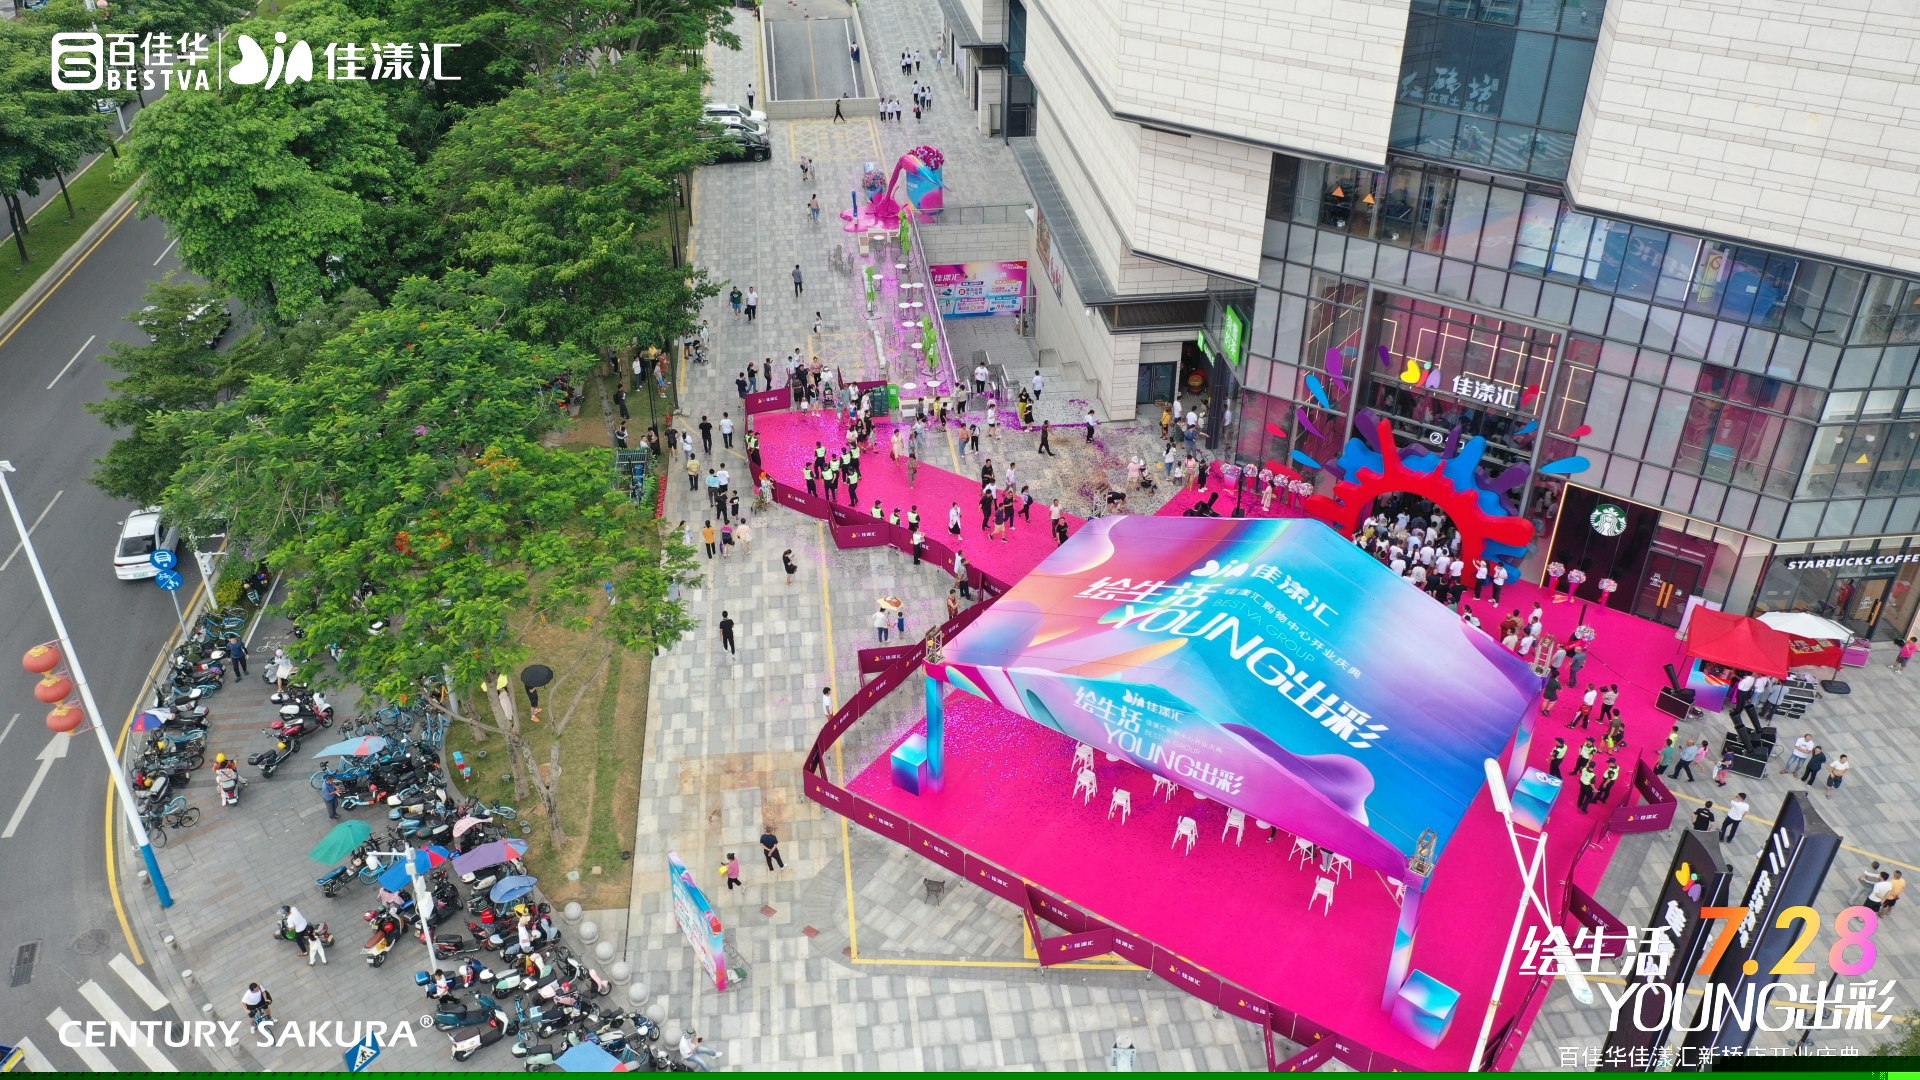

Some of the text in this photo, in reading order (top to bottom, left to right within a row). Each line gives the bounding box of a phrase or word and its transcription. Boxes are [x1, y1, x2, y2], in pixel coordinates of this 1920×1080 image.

[1452, 375, 1519, 408] 佳漾汇
[1073, 576, 1224, 608] 绘生活
[1250, 563, 1339, 627] 佳漾汇
[1788, 556, 1873, 570] STARBUCKS
[1213, 598, 1316, 663] BESTVA GROUP
[1224, 587, 1362, 680] 佳漾汇购物中心开业庆典
[1112, 605, 1389, 748] YOUNG出彩
[1073, 686, 1143, 734] 绘生活
[1104, 722, 1244, 796] YOUNG出彩
